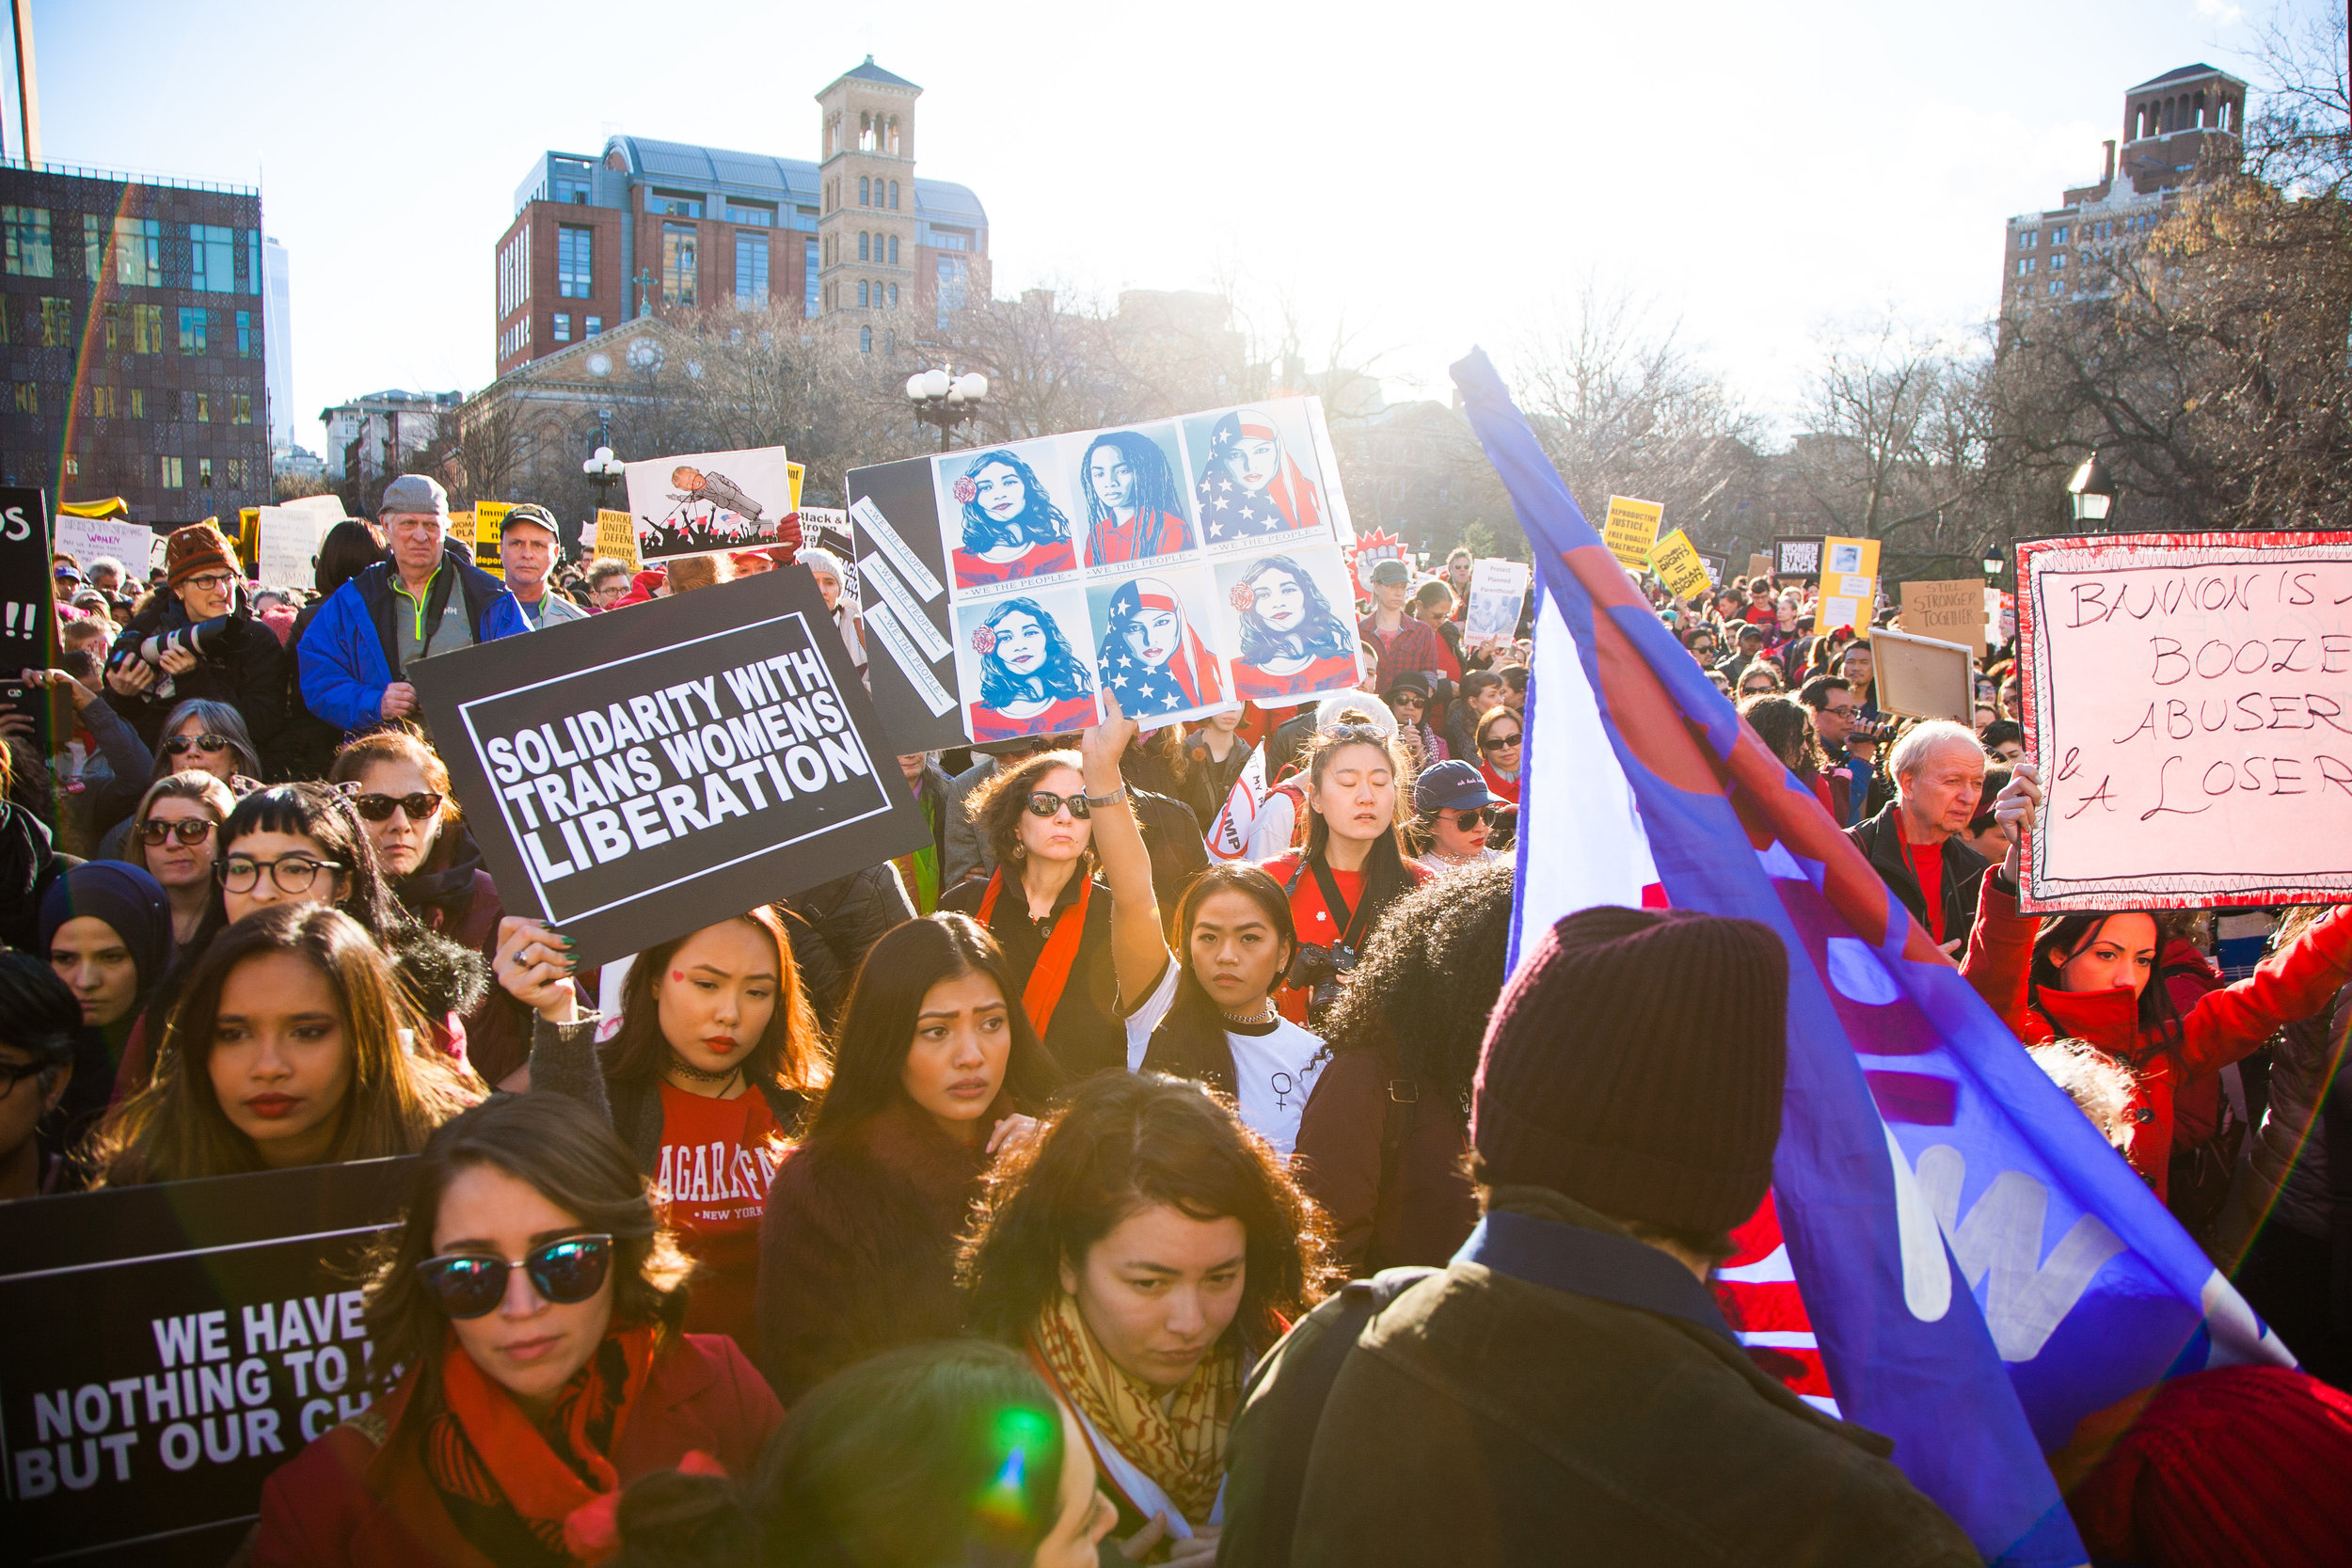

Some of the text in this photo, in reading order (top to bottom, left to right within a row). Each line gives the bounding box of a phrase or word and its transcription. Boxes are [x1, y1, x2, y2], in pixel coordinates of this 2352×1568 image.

[1611, 508, 1657, 523] REPRODUCTIVE
[1612, 517, 1644, 531] JUSTICE
[87, 532, 120, 544] WOMEN
[602, 522, 627, 534] UNITE
[1608, 531, 1652, 545] FREE QUALITY
[872, 512, 886, 528] WE
[885, 527, 901, 546] THE
[899, 545, 930, 579] PEOPLE
[1219, 542, 1238, 551] WE
[1243, 538, 1264, 547] THE
[1268, 529, 1313, 542] PEOPLE
[1607, 541, 1648, 555] HEALTHCARE
[1781, 543, 1820, 553] WOMEN
[1091, 553, 1186, 576] WE THE PEOPLE
[1660, 548, 1690, 572] RIGHTS
[1781, 552, 1818, 562] STRIKE
[1781, 562, 1818, 573] BACK
[268, 571, 310, 587] WOMAN
[971, 574, 1065, 595] WE THE PEOPLE
[1671, 565, 1701, 589] HUMAN
[1675, 572, 1704, 594] RIGHTS
[1926, 583, 1963, 593] STILL
[1481, 586, 1517, 594] Parenthood!
[2065, 570, 2316, 628] BANNON IS
[881, 567, 896, 583] WE
[894, 583, 911, 604] THE
[909, 604, 939, 640] PEOPLE
[1914, 591, 1976, 612] STRONGER
[1920, 608, 1973, 628] TOGETHER
[886, 618, 900, 636] WE
[899, 636, 914, 657] THE
[913, 657, 941, 694] PEOPLE
[2150, 634, 2352, 686] BOOZE
[487, 675, 720, 784] SOLIDARITY
[723, 648, 829, 711] WITH
[2113, 692, 2352, 745] ABUSER
[502, 690, 845, 830] TRANS WOMENS
[2065, 774, 2119, 820] A
[2141, 755, 2352, 822] LOSER
[522, 731, 871, 883] LIBERATION
[702, 1206, 764, 1221] NEW YORK
[152, 1290, 367, 1369] WE HAVE
[34, 1358, 273, 1443] NOTHING
[283, 1346, 349, 1398] TO
[15, 1432, 138, 1501] BUT
[160, 1408, 284, 1471] OUR
